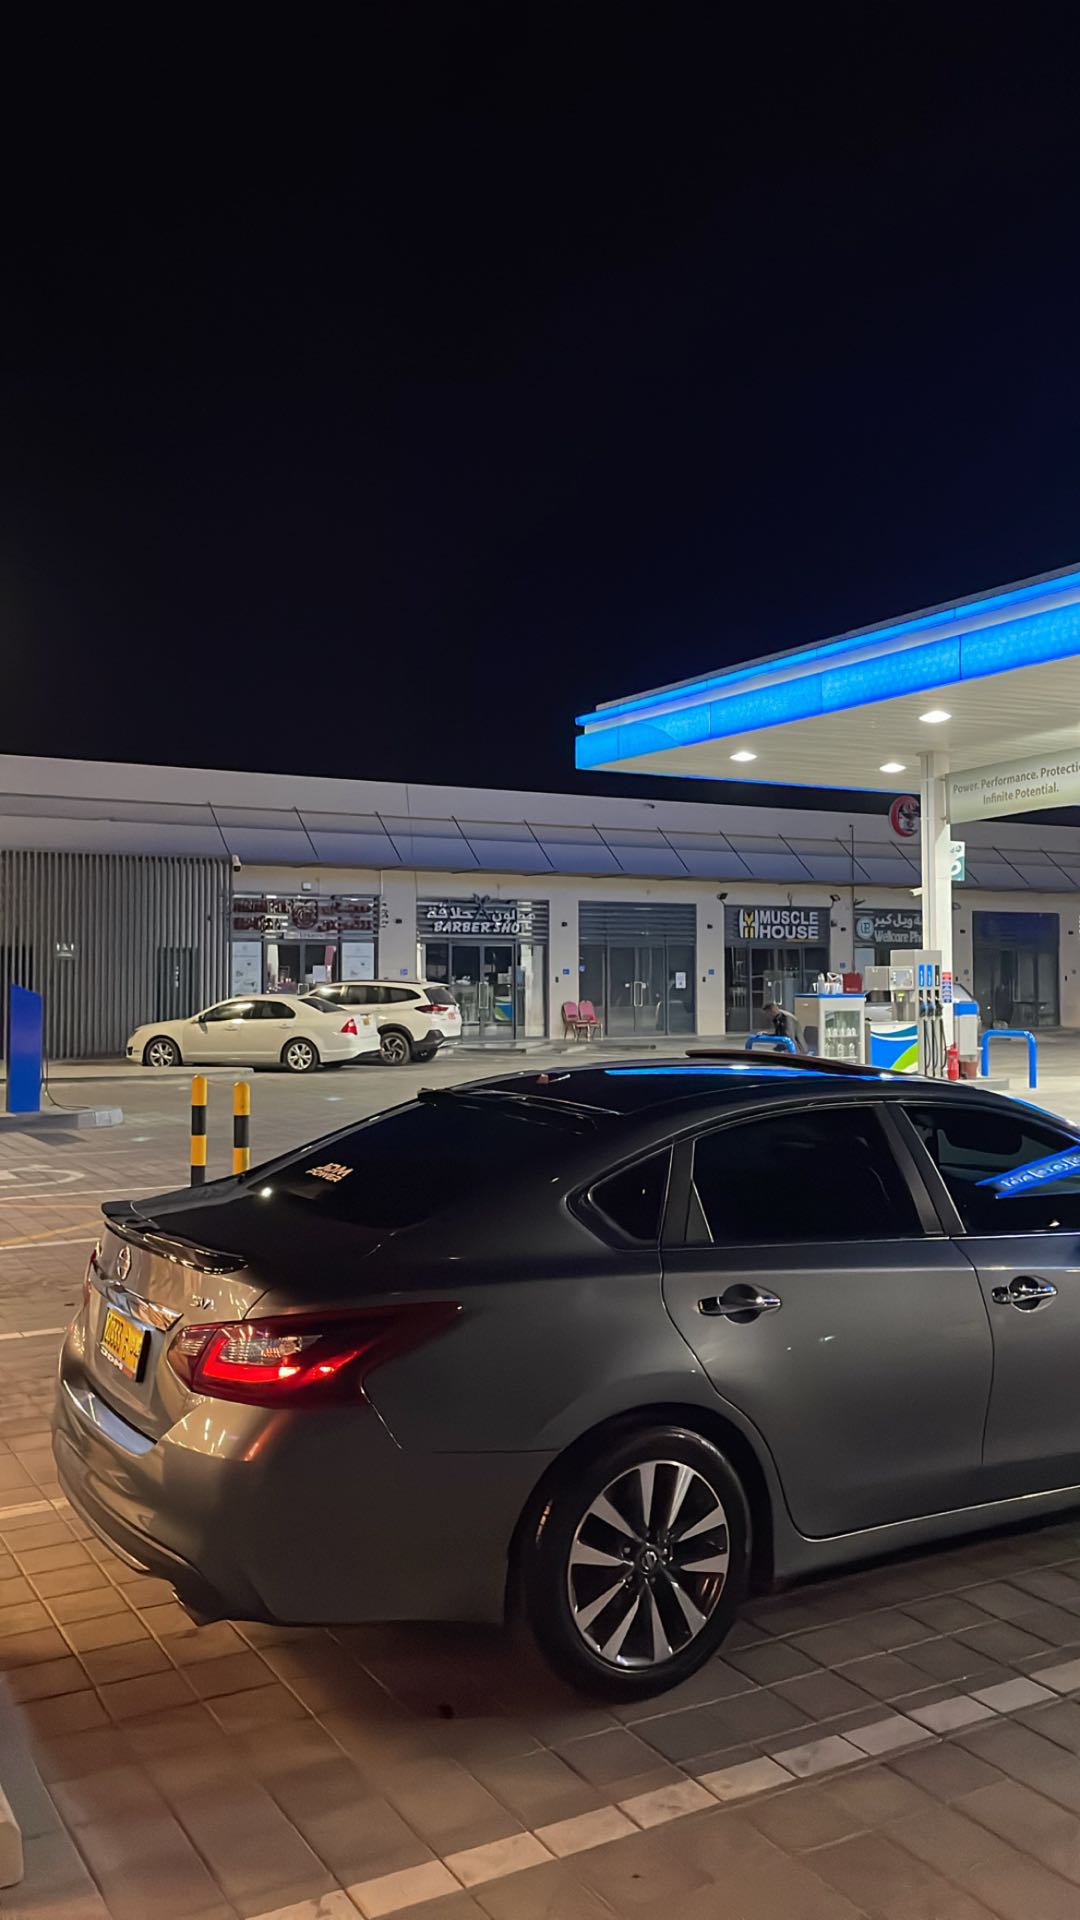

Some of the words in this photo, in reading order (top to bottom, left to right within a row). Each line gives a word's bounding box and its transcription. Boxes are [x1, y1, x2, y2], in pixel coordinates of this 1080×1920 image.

[953, 782, 979, 793] Power.
[981, 771, 1038, 789] Performance.
[983, 791, 1014, 805] Infinite
[1015, 783, 1059, 799] Potential.
[427, 903, 474, 919] حلاقة
[760, 910, 819, 925] MUSCLE
[433, 921, 491, 932] BARBER
[760, 925, 819, 939] HOUSE
